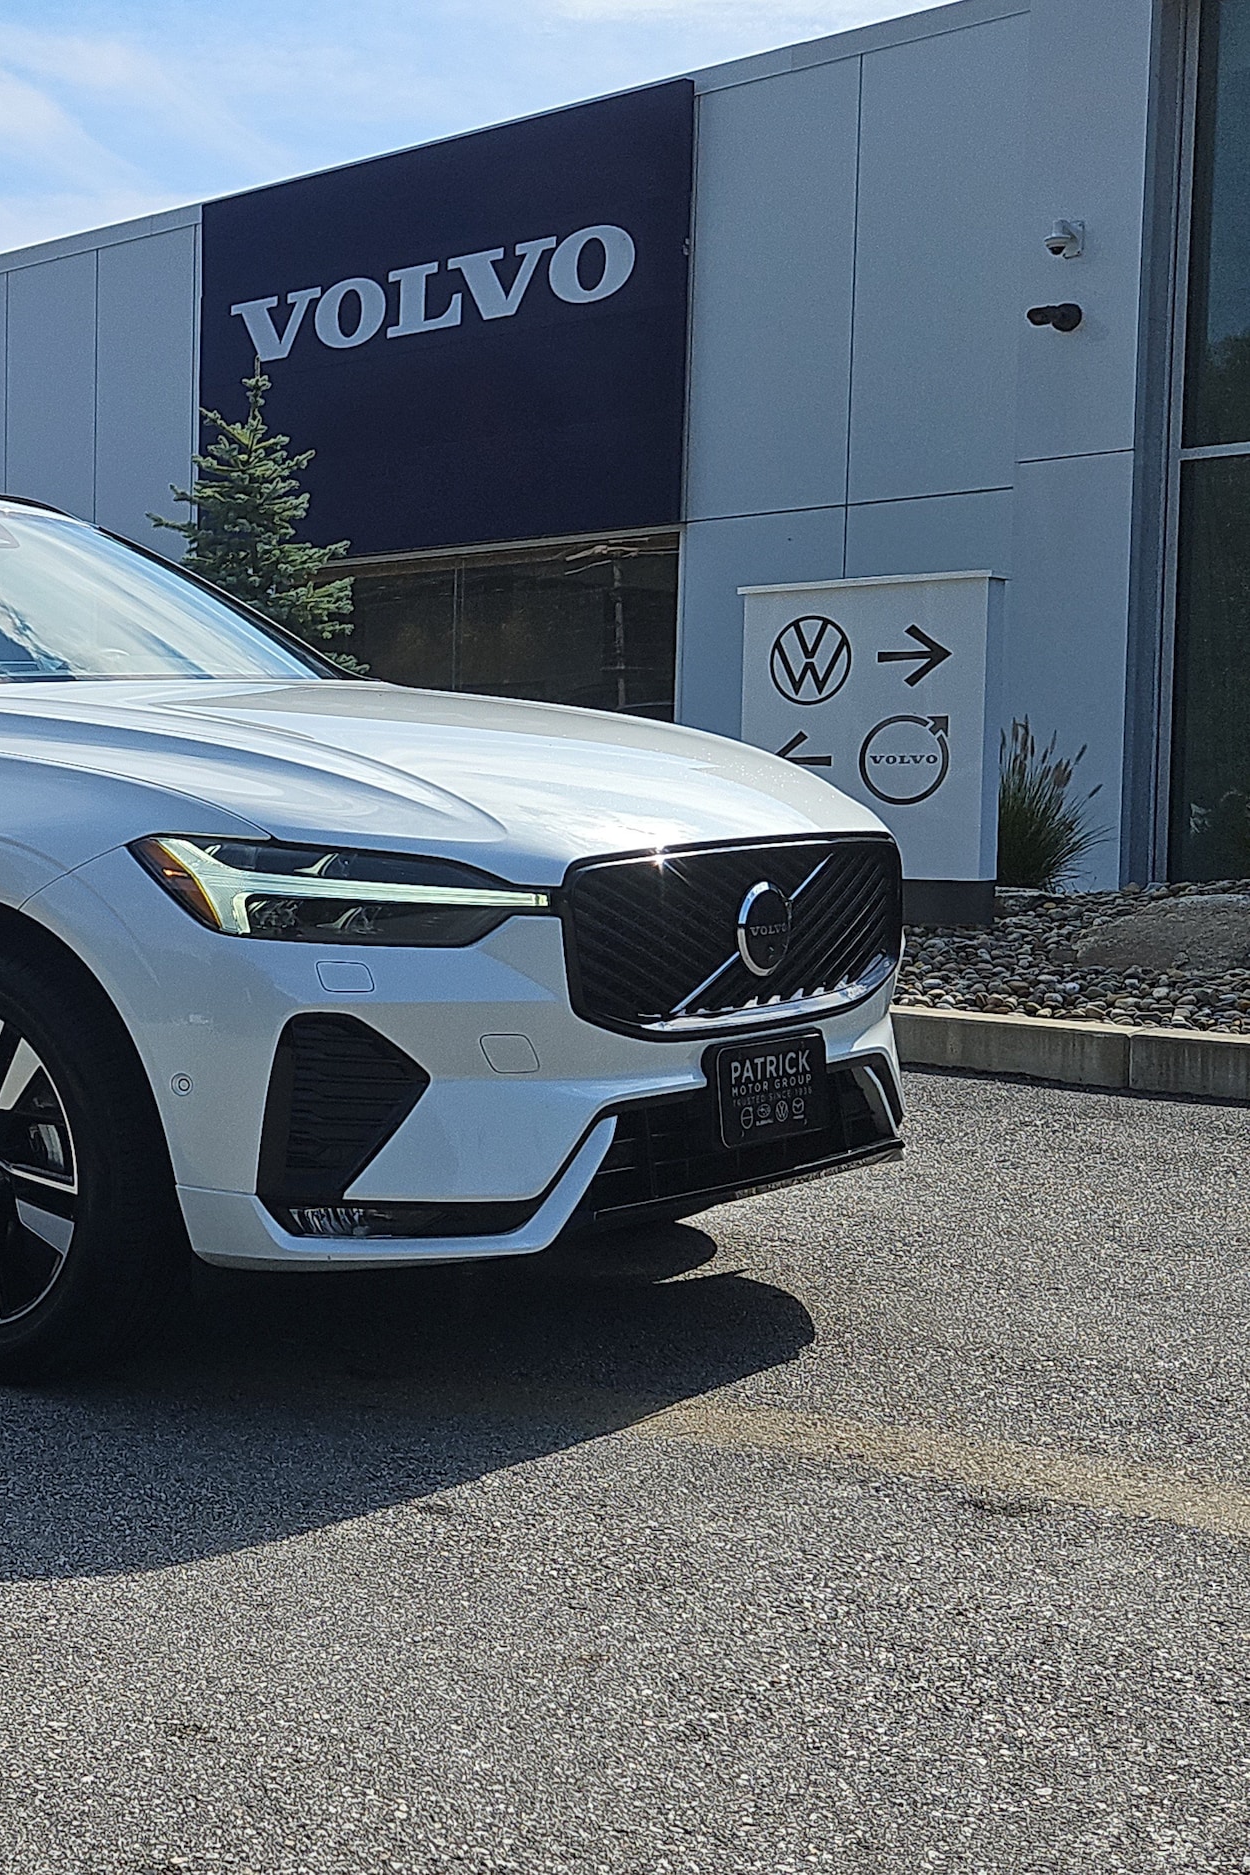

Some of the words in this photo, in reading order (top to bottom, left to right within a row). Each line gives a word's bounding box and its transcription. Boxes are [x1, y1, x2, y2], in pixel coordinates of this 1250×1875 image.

[231, 225, 635, 362] VOLVO
[870, 753, 938, 765] VOLVO
[749, 922, 787, 936] VOLVO
[731, 1050, 810, 1085] PATRICK
[731, 1080, 768, 1097] MOTOR
[774, 1073, 811, 1089] GROUP
